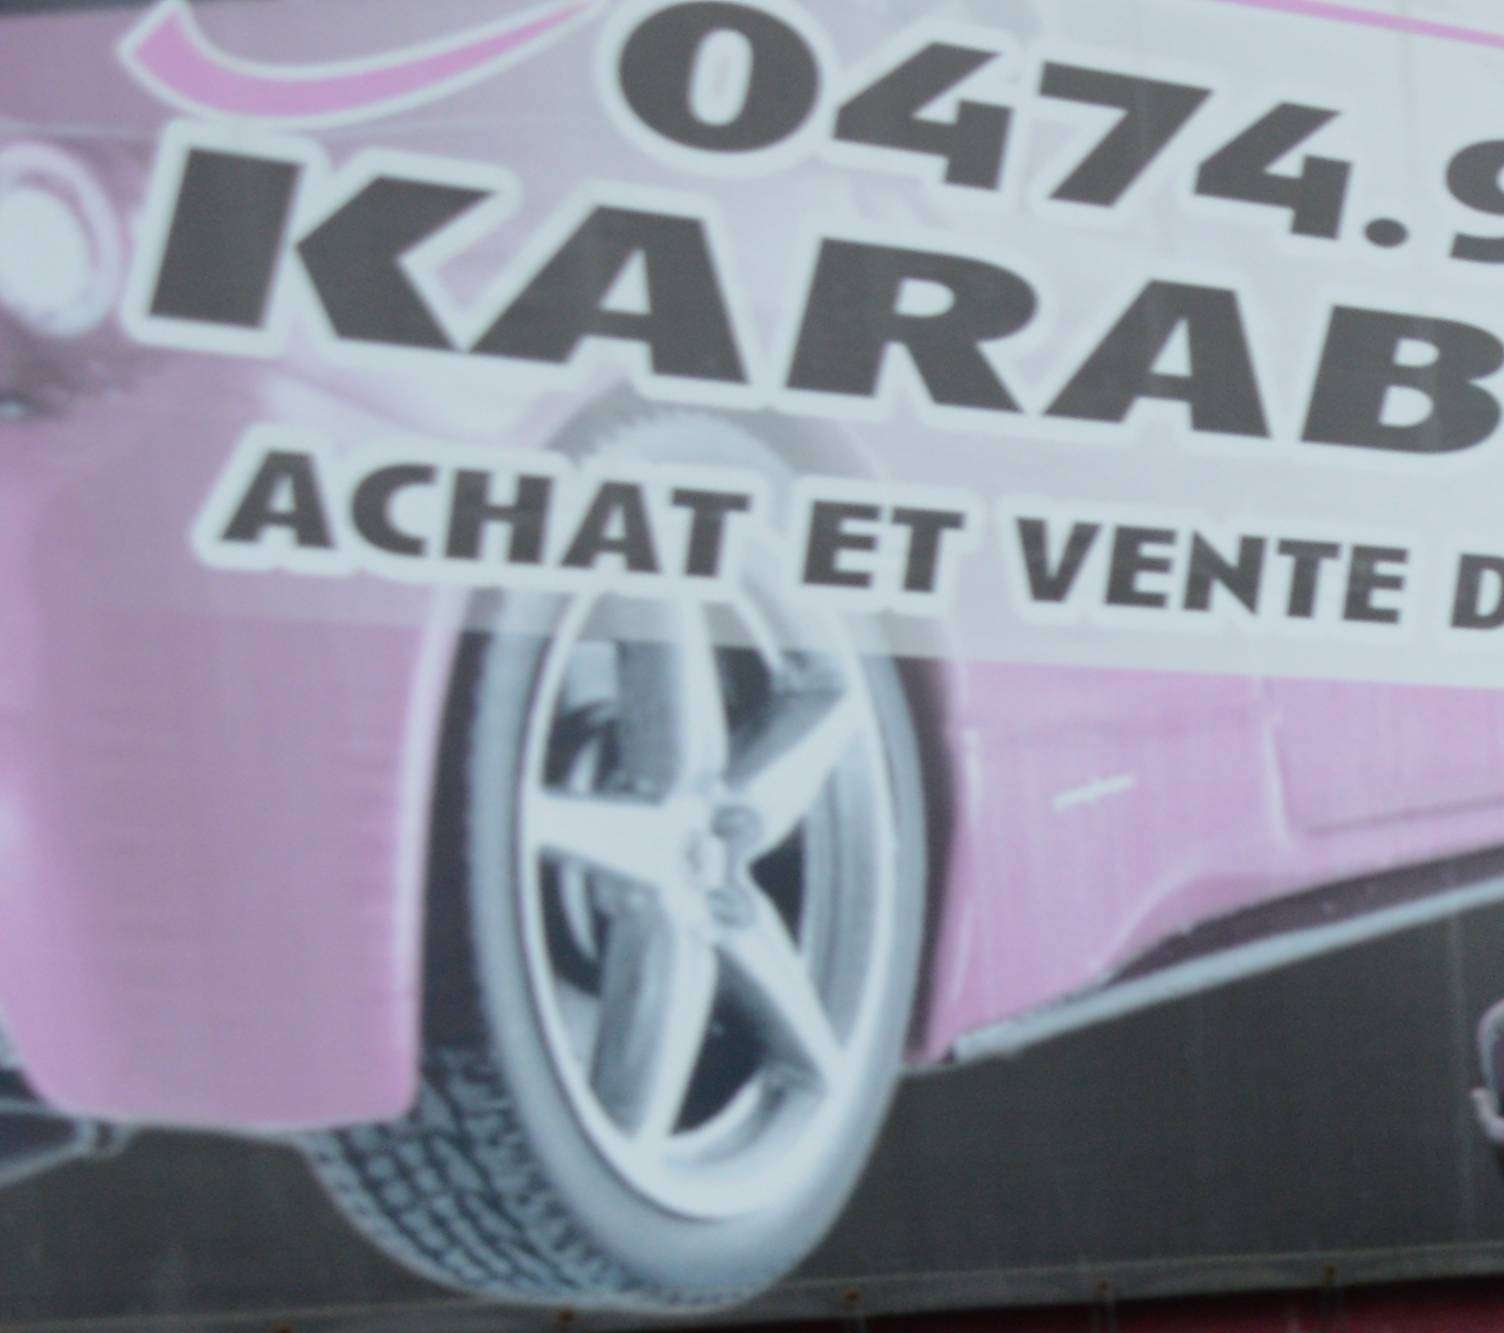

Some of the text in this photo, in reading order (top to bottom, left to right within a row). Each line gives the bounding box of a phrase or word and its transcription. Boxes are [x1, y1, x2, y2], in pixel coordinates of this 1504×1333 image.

[220, 449, 752, 580] ACHAT
[802, 499, 965, 594] ET
[1014, 516, 1408, 625] VENTE
